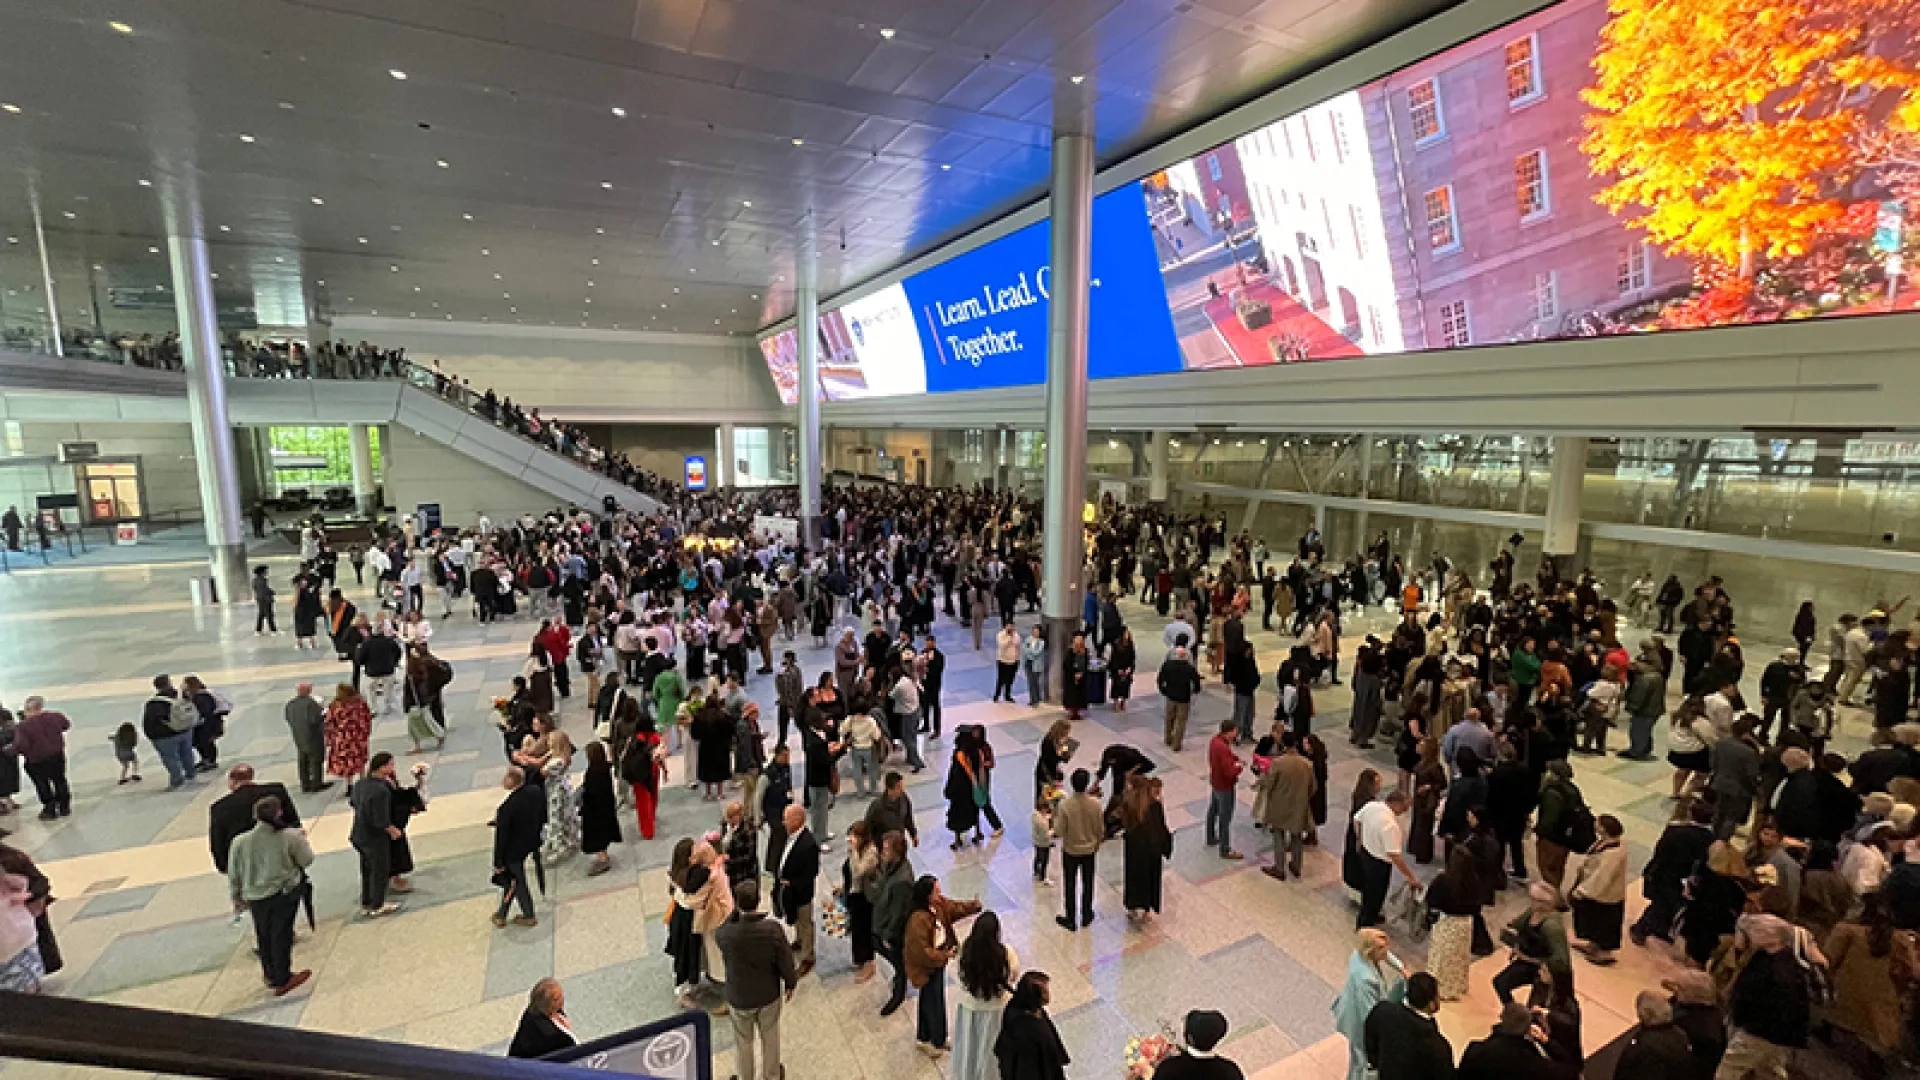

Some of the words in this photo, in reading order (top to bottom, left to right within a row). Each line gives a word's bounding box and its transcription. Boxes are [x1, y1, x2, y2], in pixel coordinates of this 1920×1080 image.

[936, 299, 986, 326] Learn.
[984, 272, 1037, 314] Lead.
[947, 326, 1023, 367] Together.
